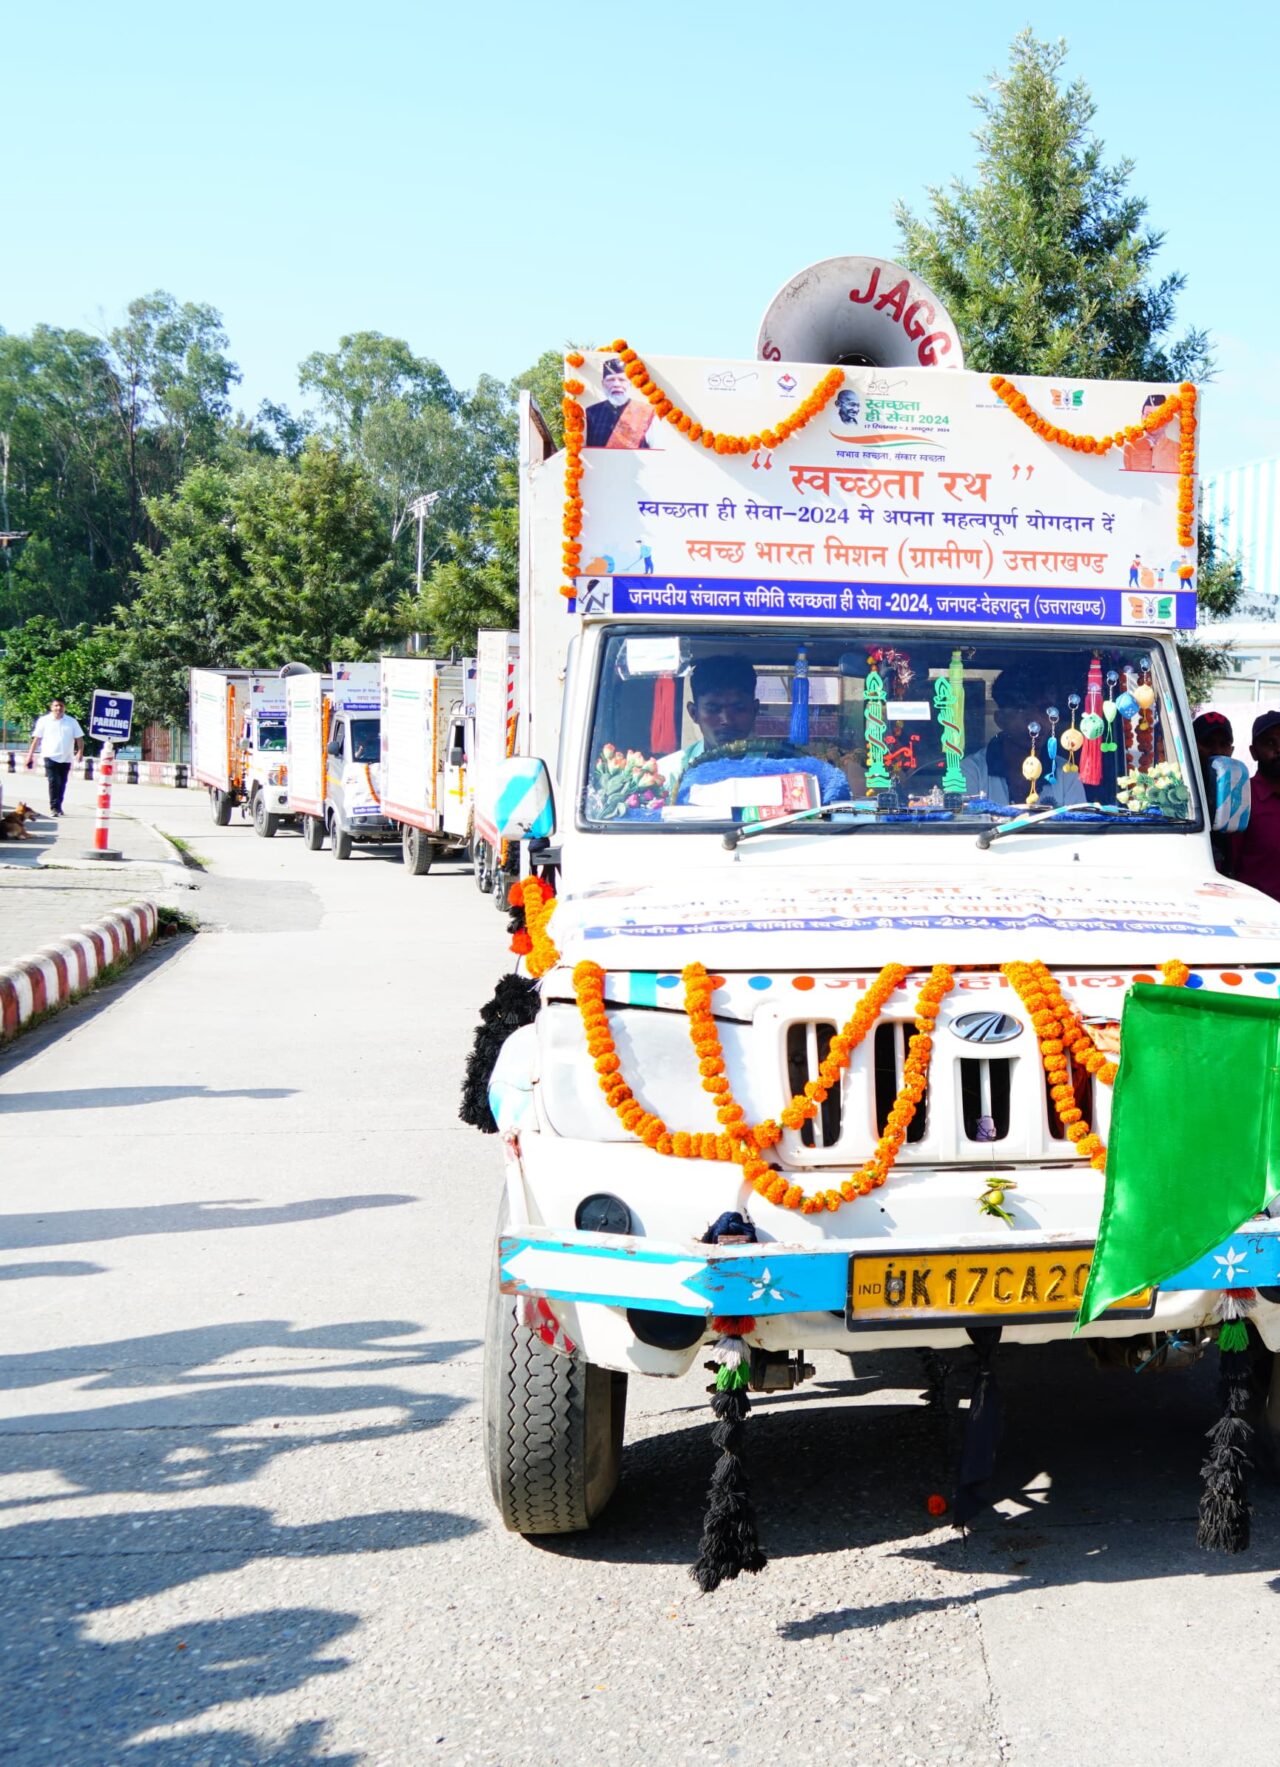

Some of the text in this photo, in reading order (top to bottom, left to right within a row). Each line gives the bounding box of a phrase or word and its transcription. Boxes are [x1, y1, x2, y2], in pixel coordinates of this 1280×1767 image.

[849, 267, 958, 368] JAGG
[865, 398, 920, 411] स्वच्छता
[865, 410, 949, 426] ही सेवा 2024
[836, 450, 860, 459] स्वभाव
[919, 454, 946, 463] स्वच्छता
[789, 465, 924, 499] स्वच्छता
[938, 471, 992, 502] रथ
[637, 501, 709, 519] स्वच्छता
[716, 497, 737, 521] ही
[883, 509, 935, 527] अपना
[942, 507, 1019, 536] महत्वपूर्ण
[1026, 509, 1095, 532] योगदान
[1101, 512, 1115, 534] दें
[686, 535, 1108, 579] स्वच्छ भारत मिशन (ग्रामीण) उत्तराखण्ड
[628, 583, 687, 607] जनपदीय
[689, 584, 740, 608] संचालन
[743, 586, 785, 609] समिति
[787, 591, 836, 610] स्वच्छता
[840, 587, 853, 612] ही
[857, 589, 882, 612] सेवा
[1034, 594, 1106, 620] (उत्तराखण्ड)
[93, 716, 129, 730] PARKING
[105, 707, 120, 718] VIP
[858, 1264, 1146, 1307] IND UK17CA20
